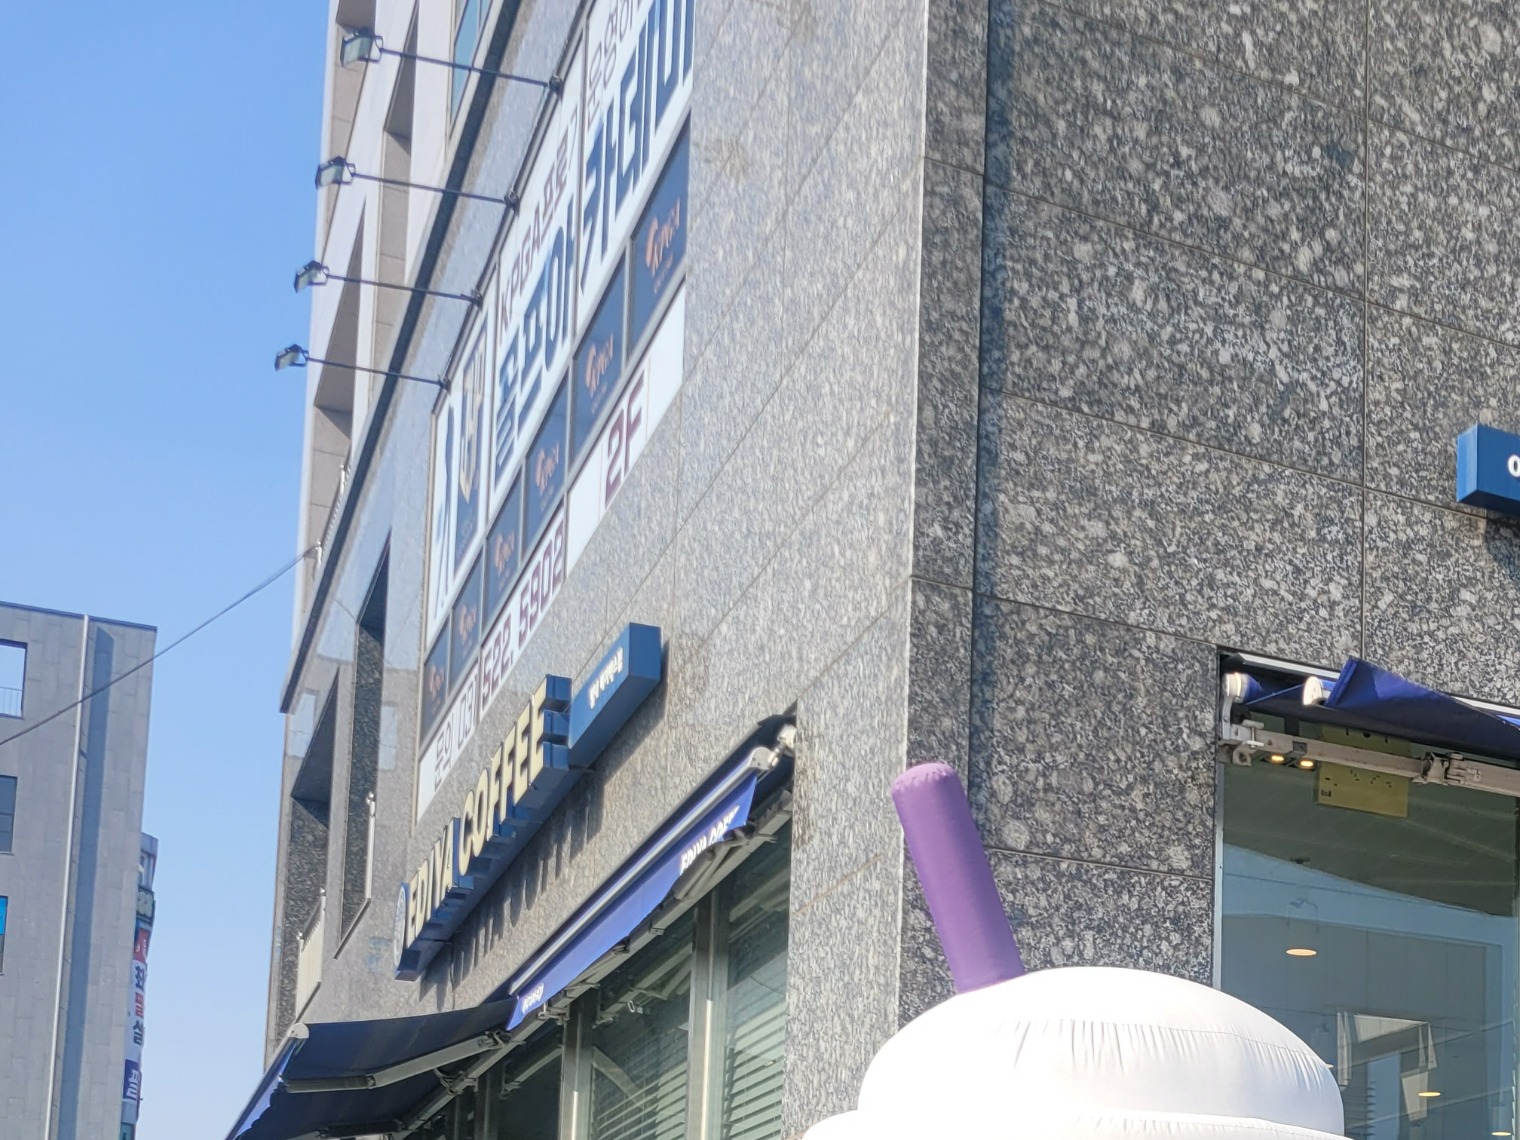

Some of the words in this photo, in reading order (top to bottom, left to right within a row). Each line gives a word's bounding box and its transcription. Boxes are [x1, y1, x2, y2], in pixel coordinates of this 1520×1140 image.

[605, 365, 647, 512] 2F
[518, 518, 565, 651] 5902
[405, 815, 453, 950] EDIYA
[458, 673, 548, 878] COFFEE
